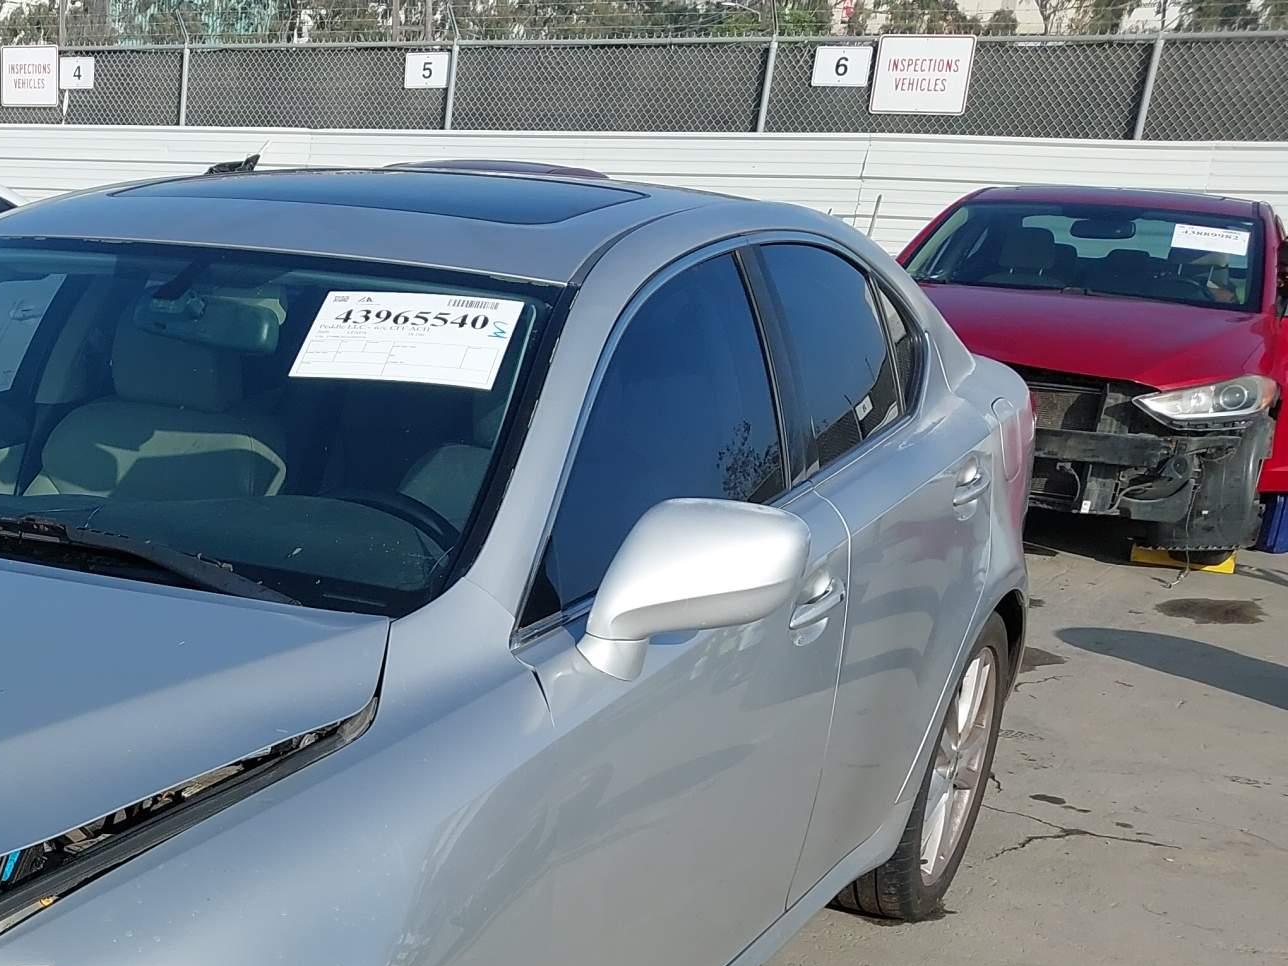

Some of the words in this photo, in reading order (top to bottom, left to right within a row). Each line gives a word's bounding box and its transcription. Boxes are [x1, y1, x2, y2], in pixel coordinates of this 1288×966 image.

[8, 63, 51, 75] INSPECTIONS
[73, 66, 82, 80] 4
[422, 62, 432, 79] 5
[835, 56, 849, 77] 6
[887, 58, 961, 73] INSPECTIONS
[13, 78, 45, 89] VEHICLES
[894, 77, 947, 92] VEHICLES
[334, 309, 489, 330] 43965540
